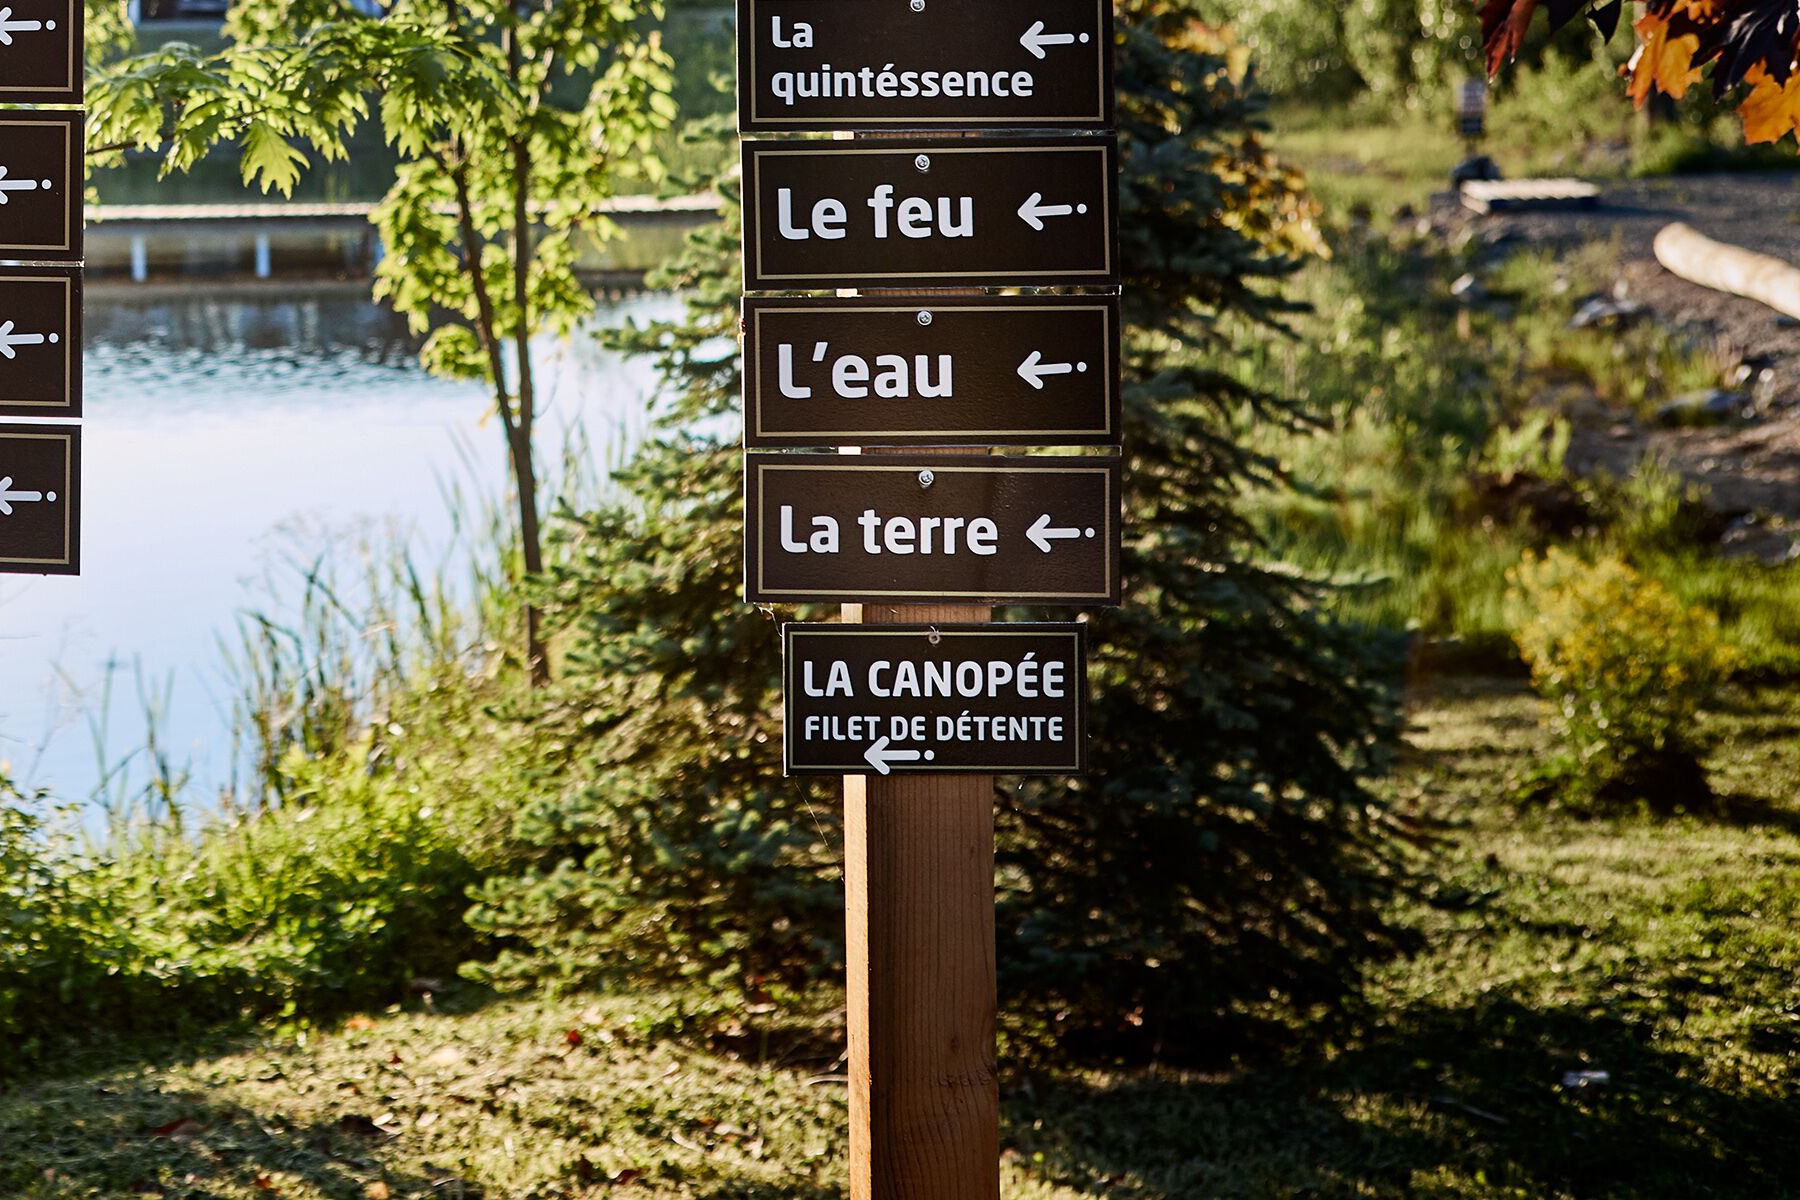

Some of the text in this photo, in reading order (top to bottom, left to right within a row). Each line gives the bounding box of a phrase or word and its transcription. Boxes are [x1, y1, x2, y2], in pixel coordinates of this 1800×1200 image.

[771, 15, 813, 48] La
[771, 63, 1034, 106] quintéssence
[777, 184, 974, 240] Le feu
[778, 341, 953, 399] L'eau
[780, 505, 998, 556] La terre
[803, 652, 1064, 698] LA CANOPÉE
[805, 710, 1063, 741] FILET DE DÉTENTE
